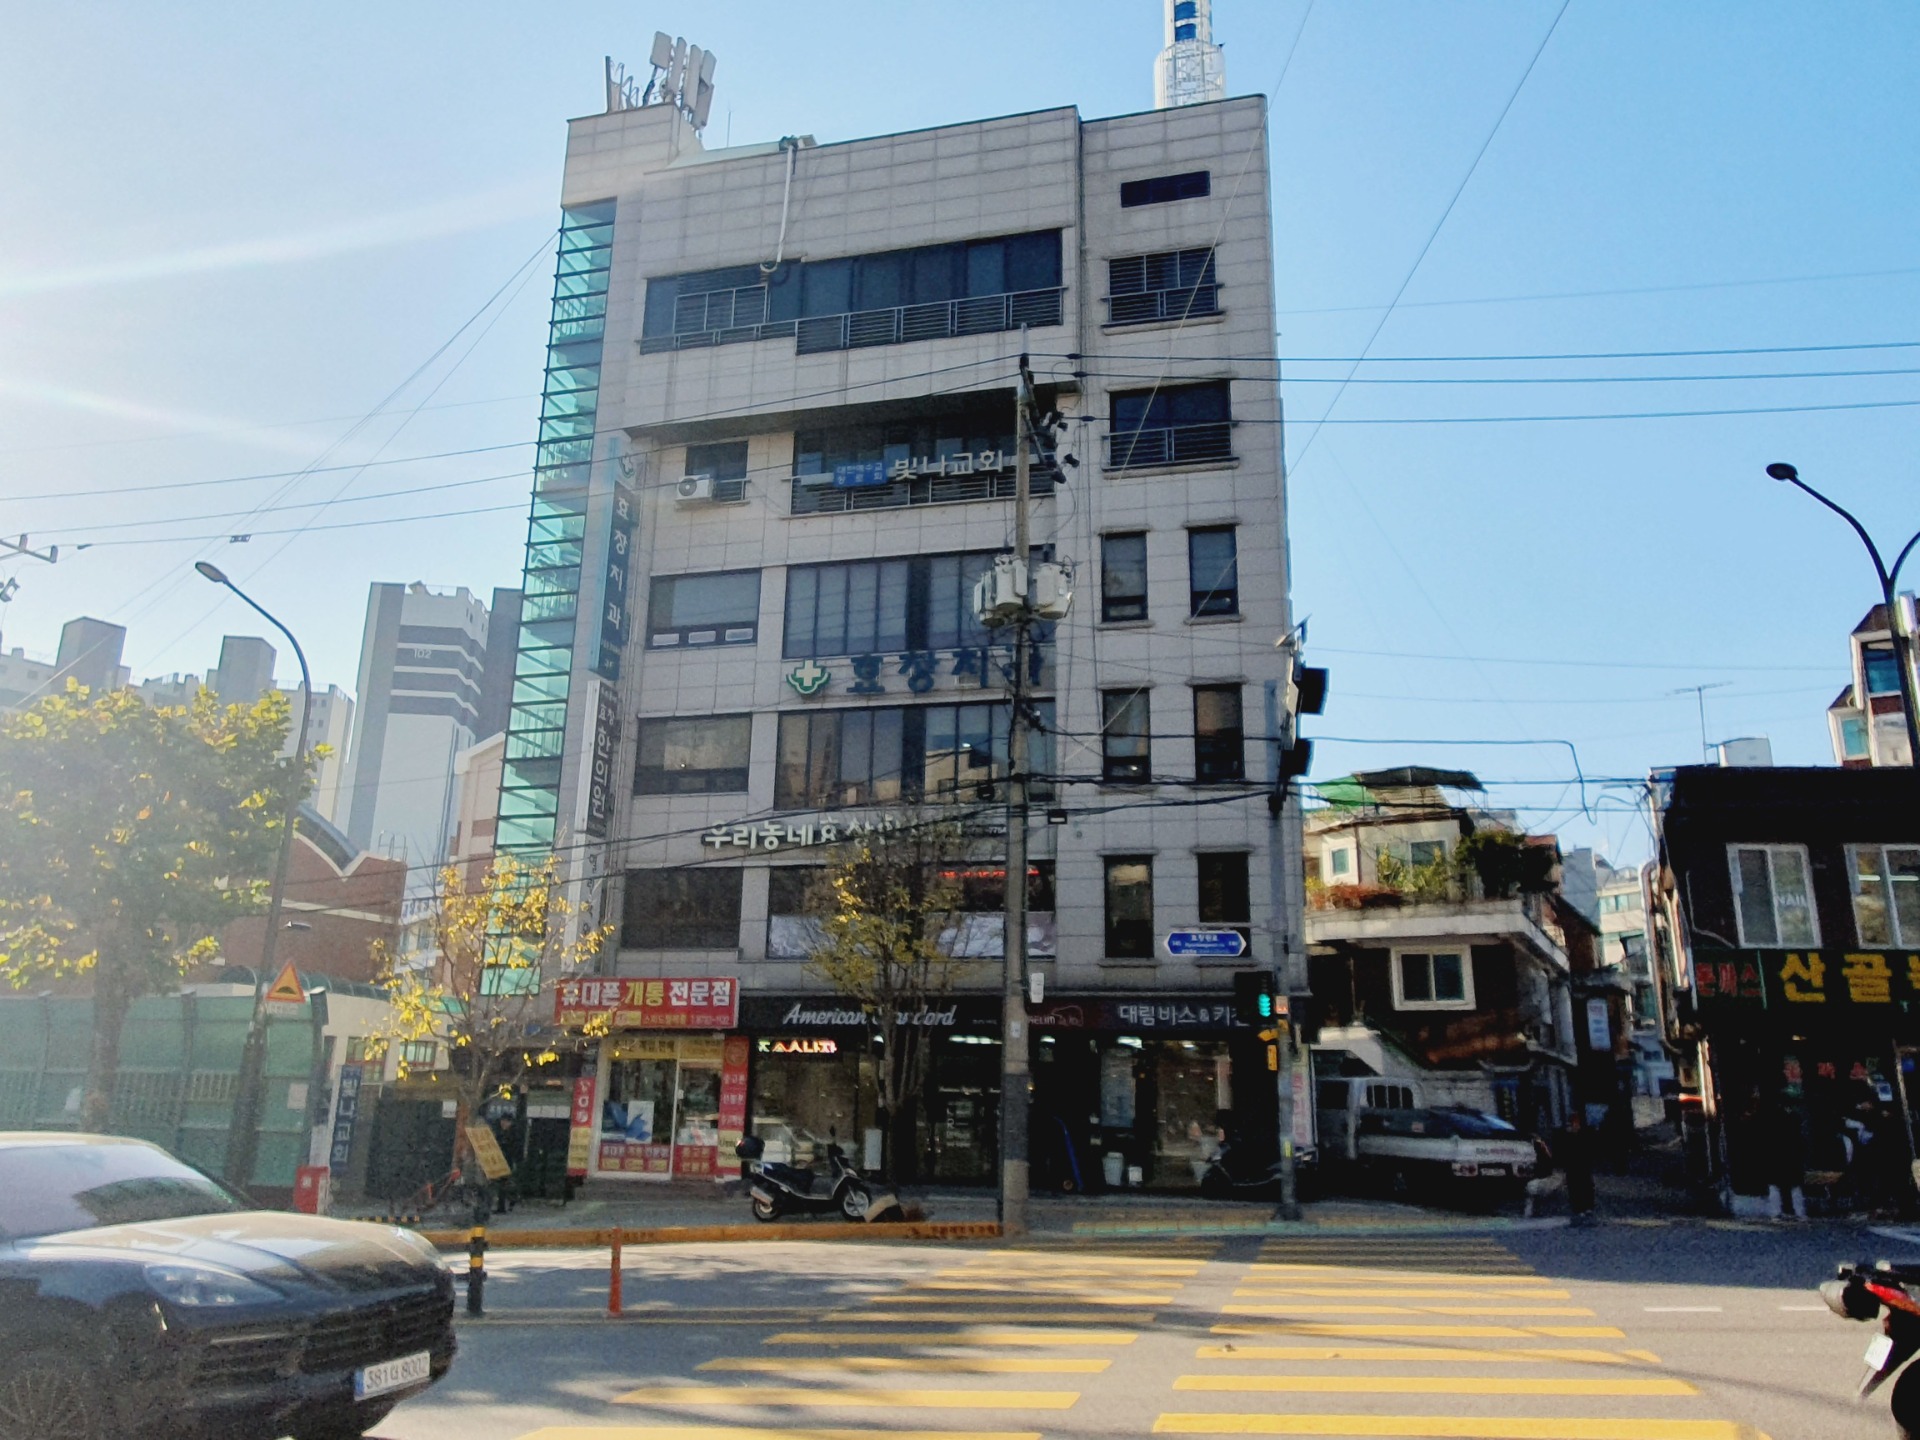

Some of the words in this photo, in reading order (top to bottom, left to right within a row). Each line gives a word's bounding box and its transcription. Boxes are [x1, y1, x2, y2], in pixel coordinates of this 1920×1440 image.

[894, 450, 1004, 481] 빛나교회
[414, 648, 432, 659] 102
[592, 725, 612, 820] 한의원
[1778, 952, 1920, 1003] 산골
[562, 981, 620, 1007] 휴대폰
[625, 981, 664, 1006] 개통
[669, 980, 731, 1007] 전문점
[783, 1003, 868, 1026] American
